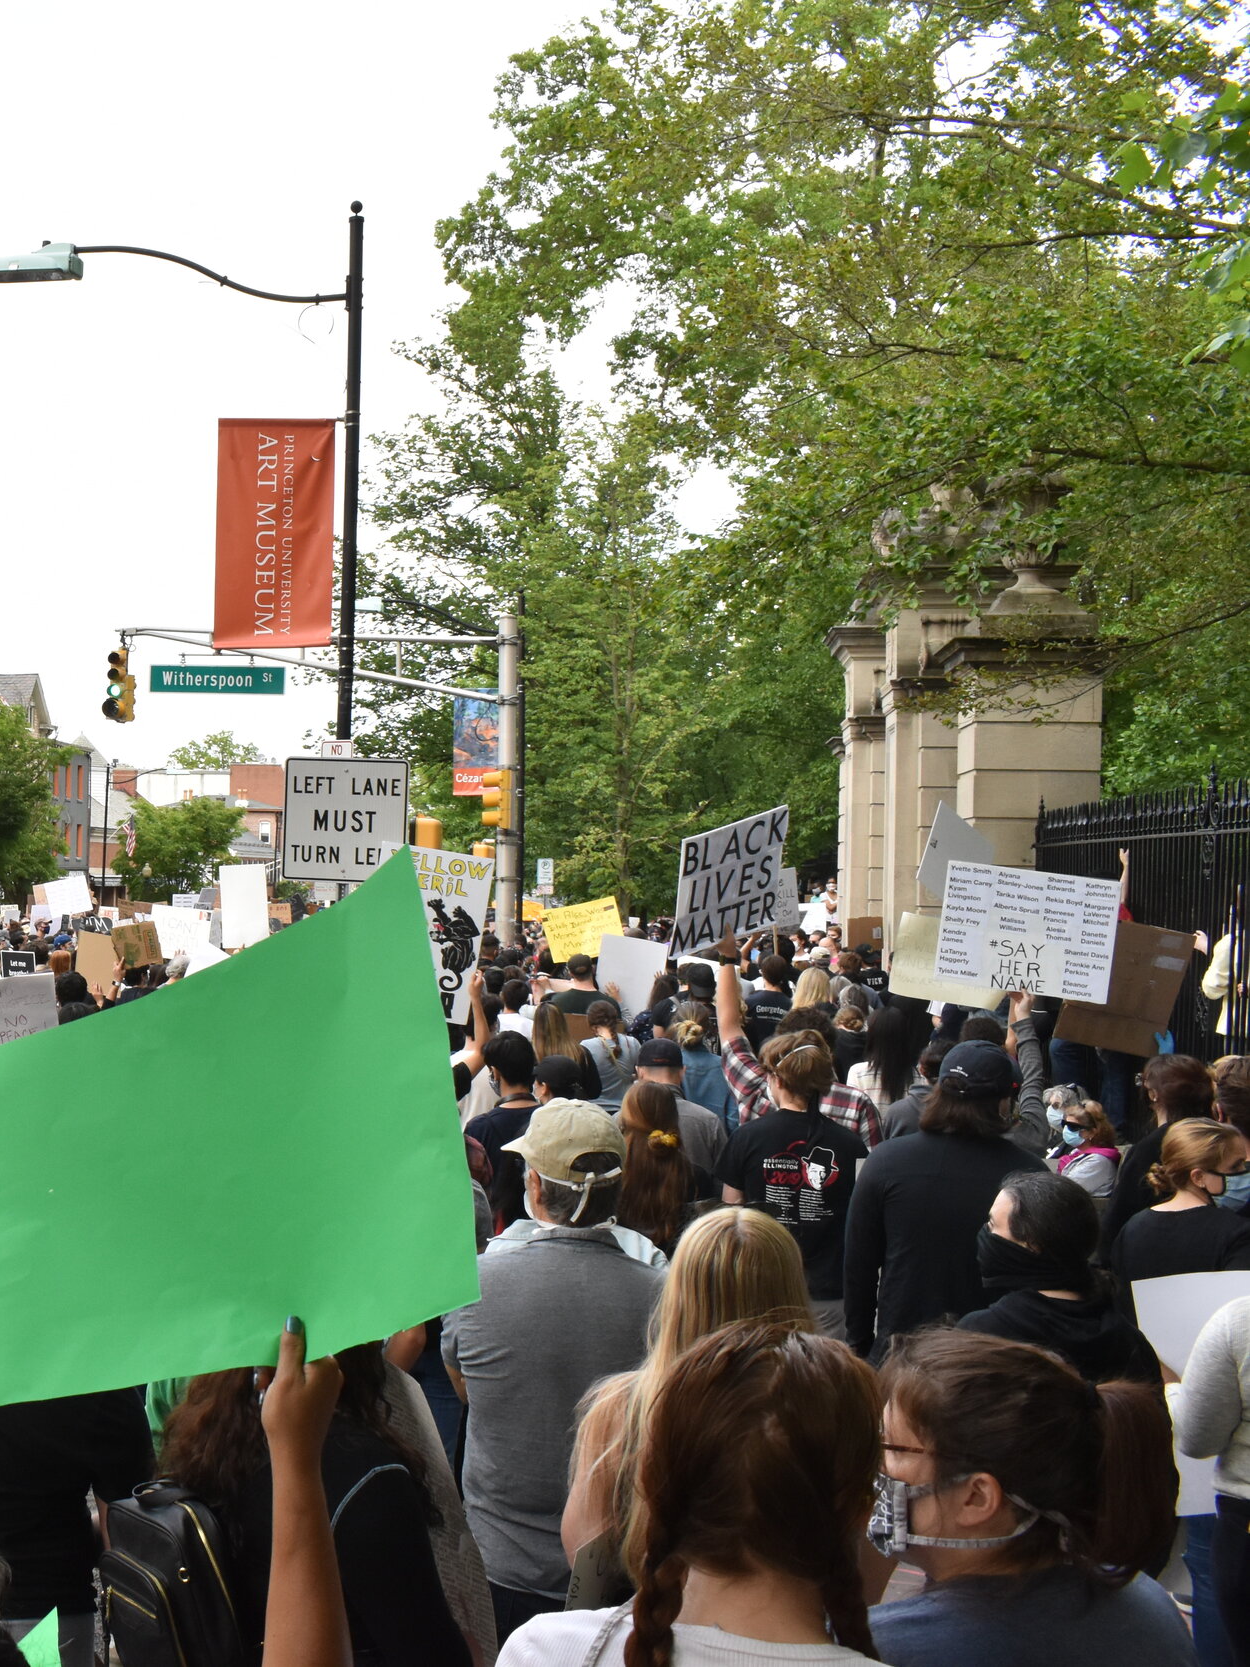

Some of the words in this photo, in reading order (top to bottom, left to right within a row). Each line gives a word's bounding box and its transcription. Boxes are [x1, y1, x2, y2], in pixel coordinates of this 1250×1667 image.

[257, 431, 279, 493] ART
[282, 434, 295, 530] PRINCETON
[253, 501, 277, 637] MUSEUM
[280, 537, 294, 636] UNIVERSITY
[162, 671, 253, 689] Witherspoon
[262, 672, 273, 683] St
[293, 775, 335, 795] LEFT
[352, 777, 401, 797] LANE
[313, 809, 377, 833] MUST
[682, 809, 789, 877] BLACK
[291, 844, 340, 864] TURN
[391, 849, 492, 880] ELLOW
[951, 864, 971, 874] Yvette
[973, 867, 992, 875] Smith
[688, 855, 773, 914] LIVES
[950, 877, 972, 886] Miriam
[973, 879, 993, 888] Carey
[997, 879, 1044, 891] Stanley-Jones
[1047, 885, 1076, 893] Edwards
[947, 893, 981, 902] Livingston
[1017, 893, 1039, 902] Wilson
[994, 902, 1019, 912] Alberta
[1066, 899, 1083, 908] Boyd
[1084, 903, 1114, 912] Margaret
[946, 904, 965, 914] Kayla
[1083, 911, 1111, 919] LaVerne
[669, 890, 776, 957] MATTER
[945, 916, 964, 925] Shelly
[965, 918, 981, 926] Frey
[1043, 917, 1068, 925] Francis
[942, 928, 967, 937] Kendra
[999, 924, 1027, 933] Williams
[1046, 934, 1072, 942] Thomas
[1081, 930, 1108, 939] Danette
[941, 936, 964, 944] James
[1080, 938, 1106, 947] Daniels
[940, 947, 968, 956] LaTanya
[989, 939, 1046, 960] #SAY
[939, 955, 970, 965] Haggerty
[1090, 952, 1110, 960] Davis
[9, 960, 18, 968] Let
[999, 959, 1041, 978] HER
[1065, 960, 1091, 969] Frankie
[938, 967, 959, 976] Tyisha
[959, 969, 978, 978] Miller
[1064, 968, 1089, 977] Perkins
[991, 974, 1046, 994] NAME
[1063, 980, 1088, 989] Eleanor
[1062, 988, 1092, 997] Bumpurs
[3, 1014, 28, 1028] NO
[762, 1162, 799, 1170] ELLINGTON
[763, 1158, 799, 1166] essentially
